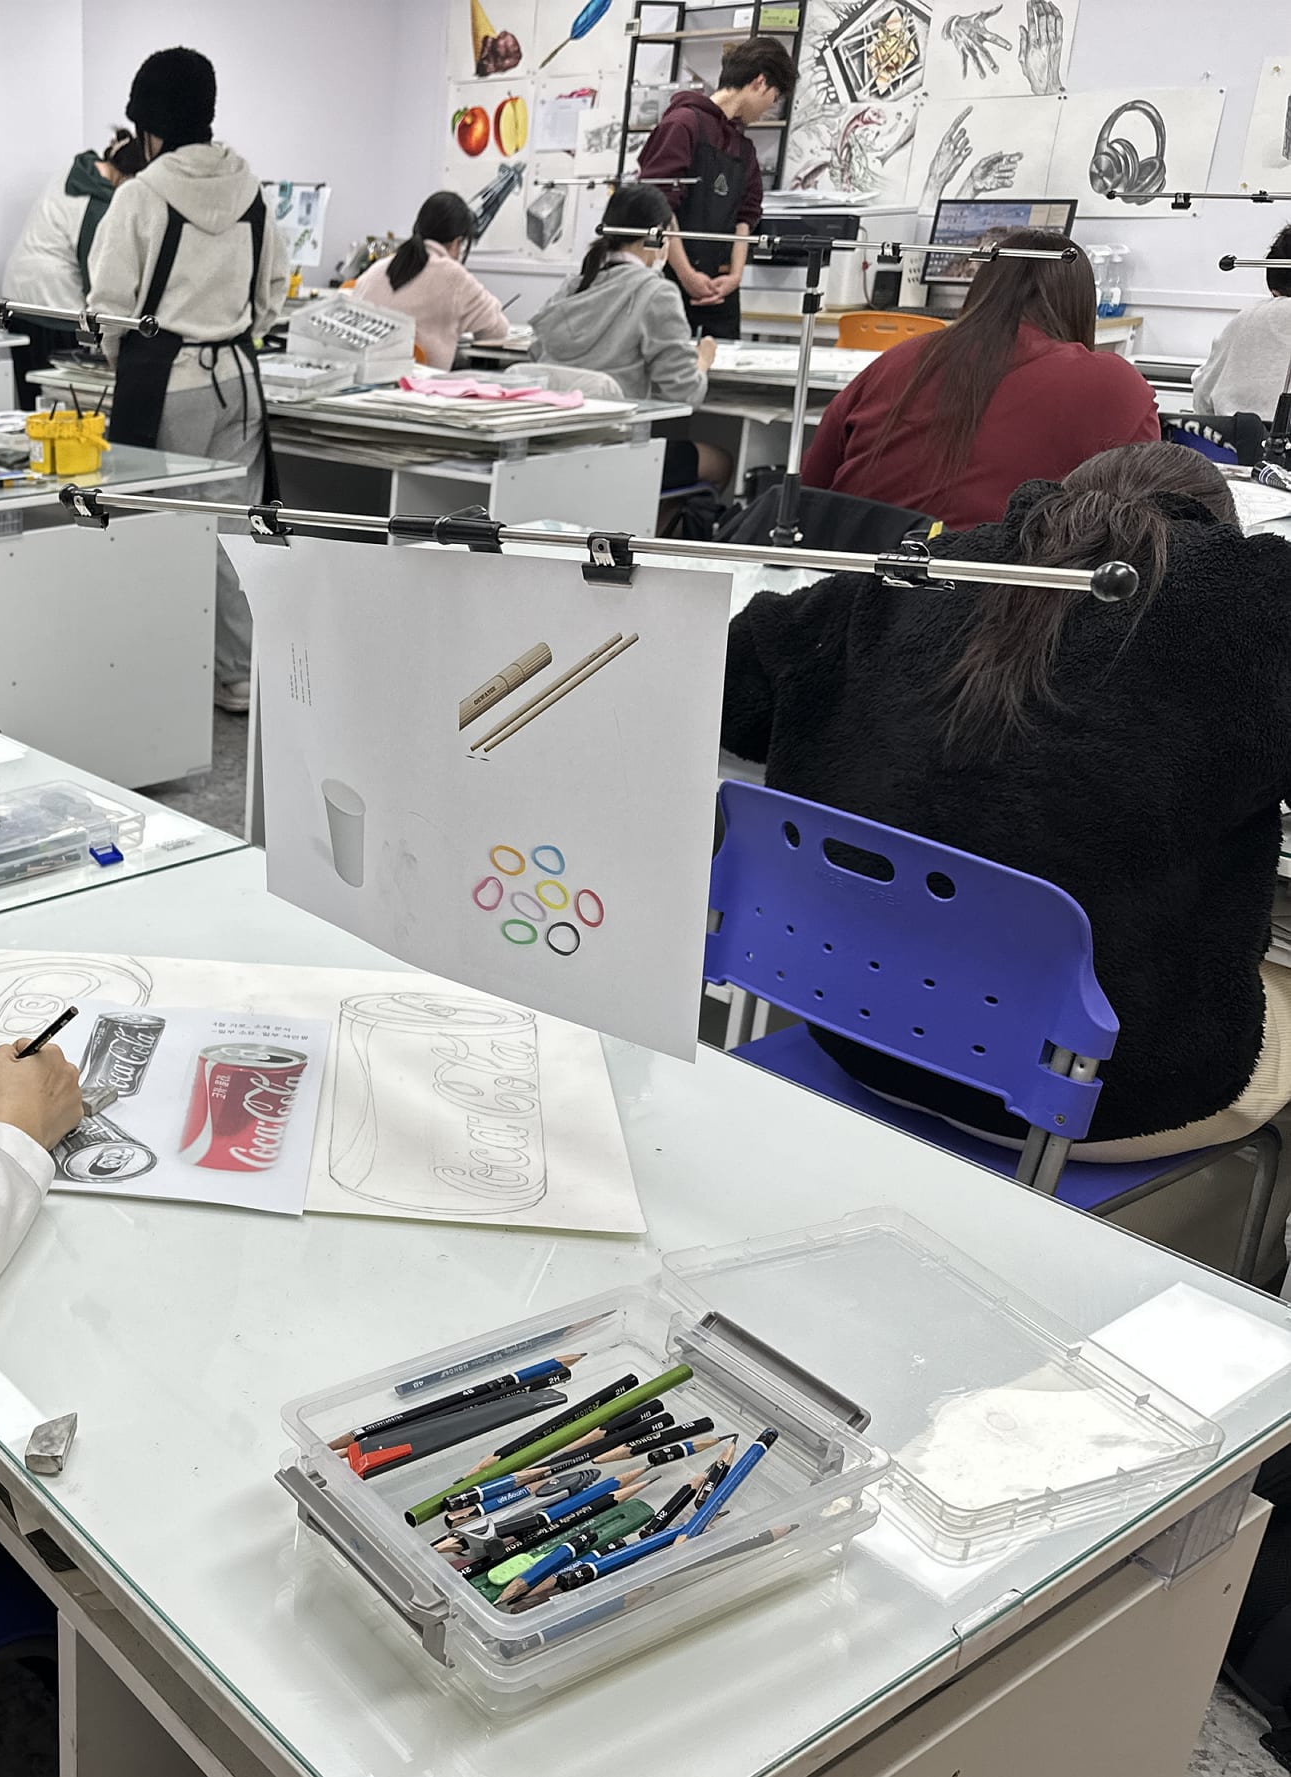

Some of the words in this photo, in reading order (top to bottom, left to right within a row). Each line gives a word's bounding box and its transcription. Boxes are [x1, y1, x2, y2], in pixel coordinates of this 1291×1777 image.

[548, 1375, 560, 1385] 2H
[462, 1388, 476, 1397] 4B
[615, 1385, 626, 1396] 2H
[640, 1410, 652, 1420] HB
[651, 1421, 664, 1431] HB
[656, 1510, 668, 1521] 2H
